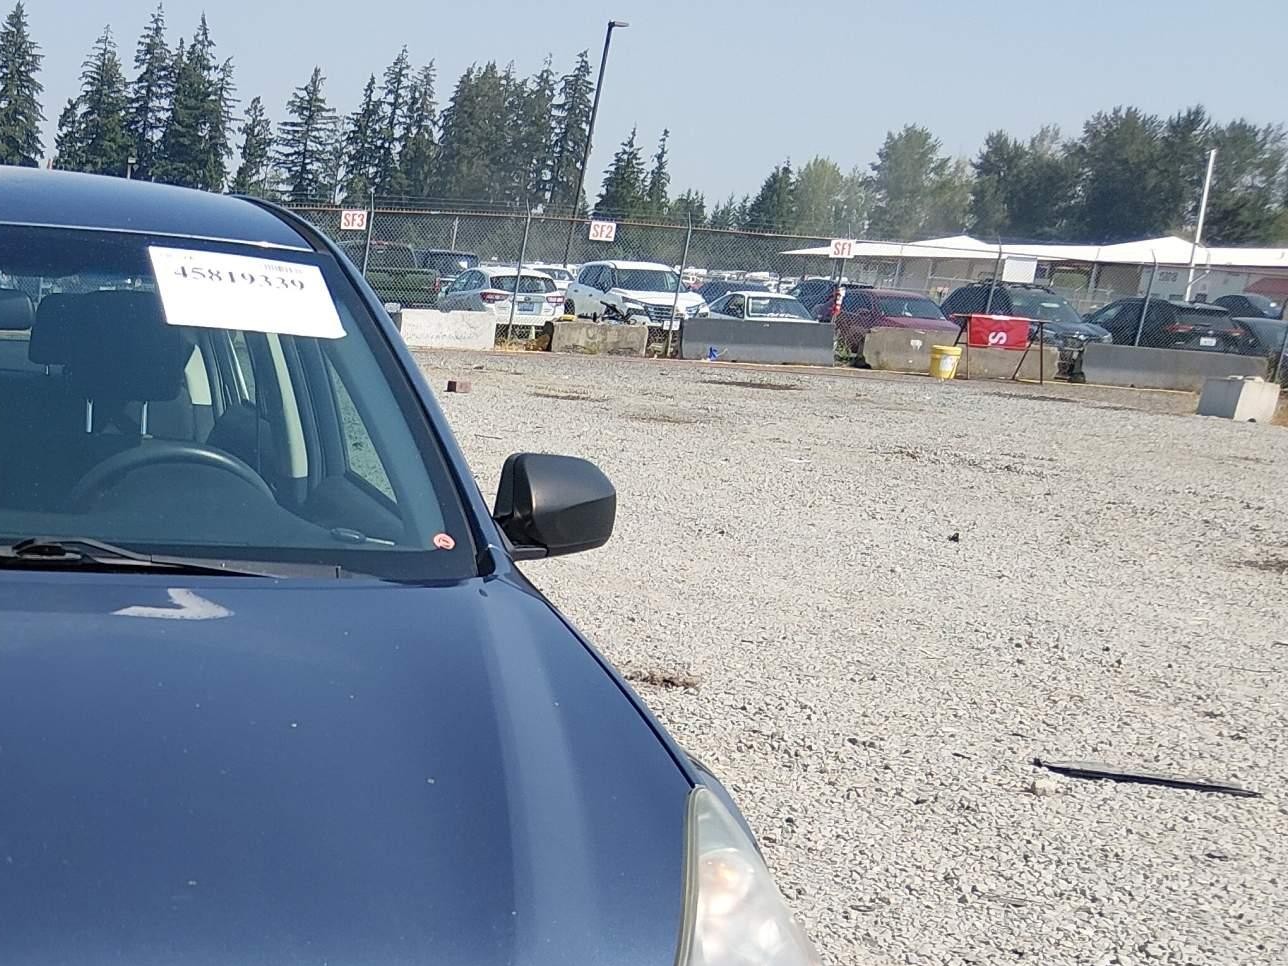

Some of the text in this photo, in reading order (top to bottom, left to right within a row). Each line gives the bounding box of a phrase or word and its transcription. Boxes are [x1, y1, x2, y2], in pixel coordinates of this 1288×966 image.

[344, 212, 365, 228] SF3
[592, 223, 614, 239] SF2
[833, 241, 852, 256] SF1
[173, 264, 306, 291] 45819339
